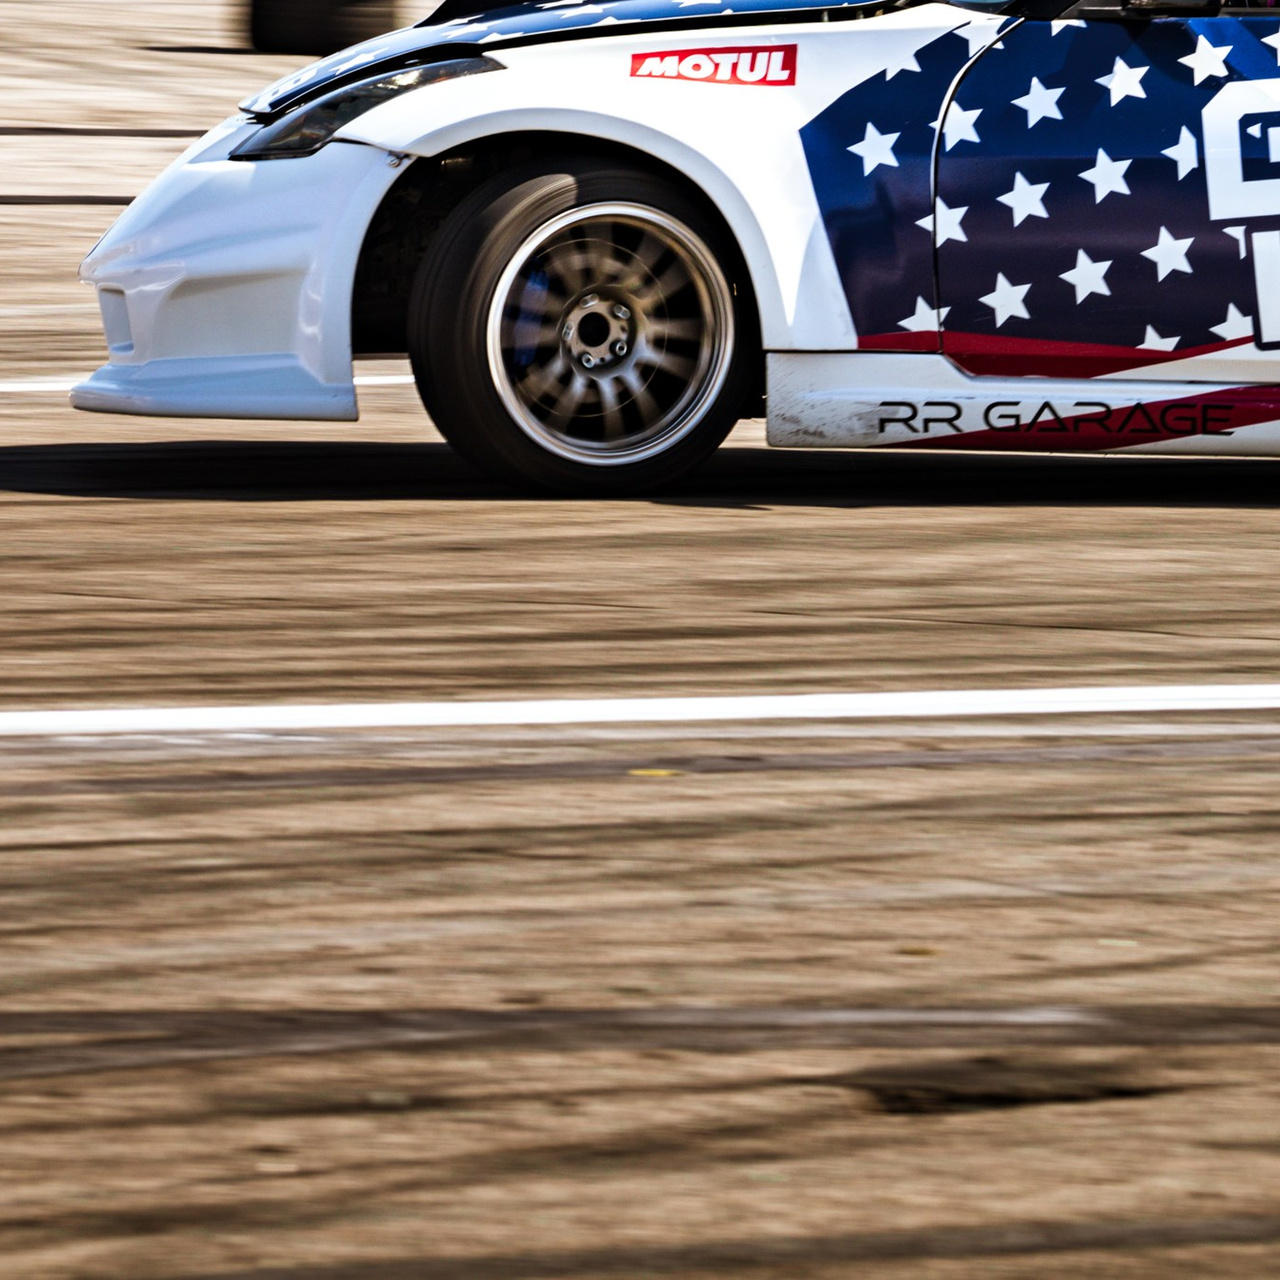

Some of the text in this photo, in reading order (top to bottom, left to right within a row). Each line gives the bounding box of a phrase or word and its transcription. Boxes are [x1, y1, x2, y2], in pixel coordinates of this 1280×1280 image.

[636, 51, 790, 82] MOTUL
[878, 401, 1236, 437] RR GARAGE
